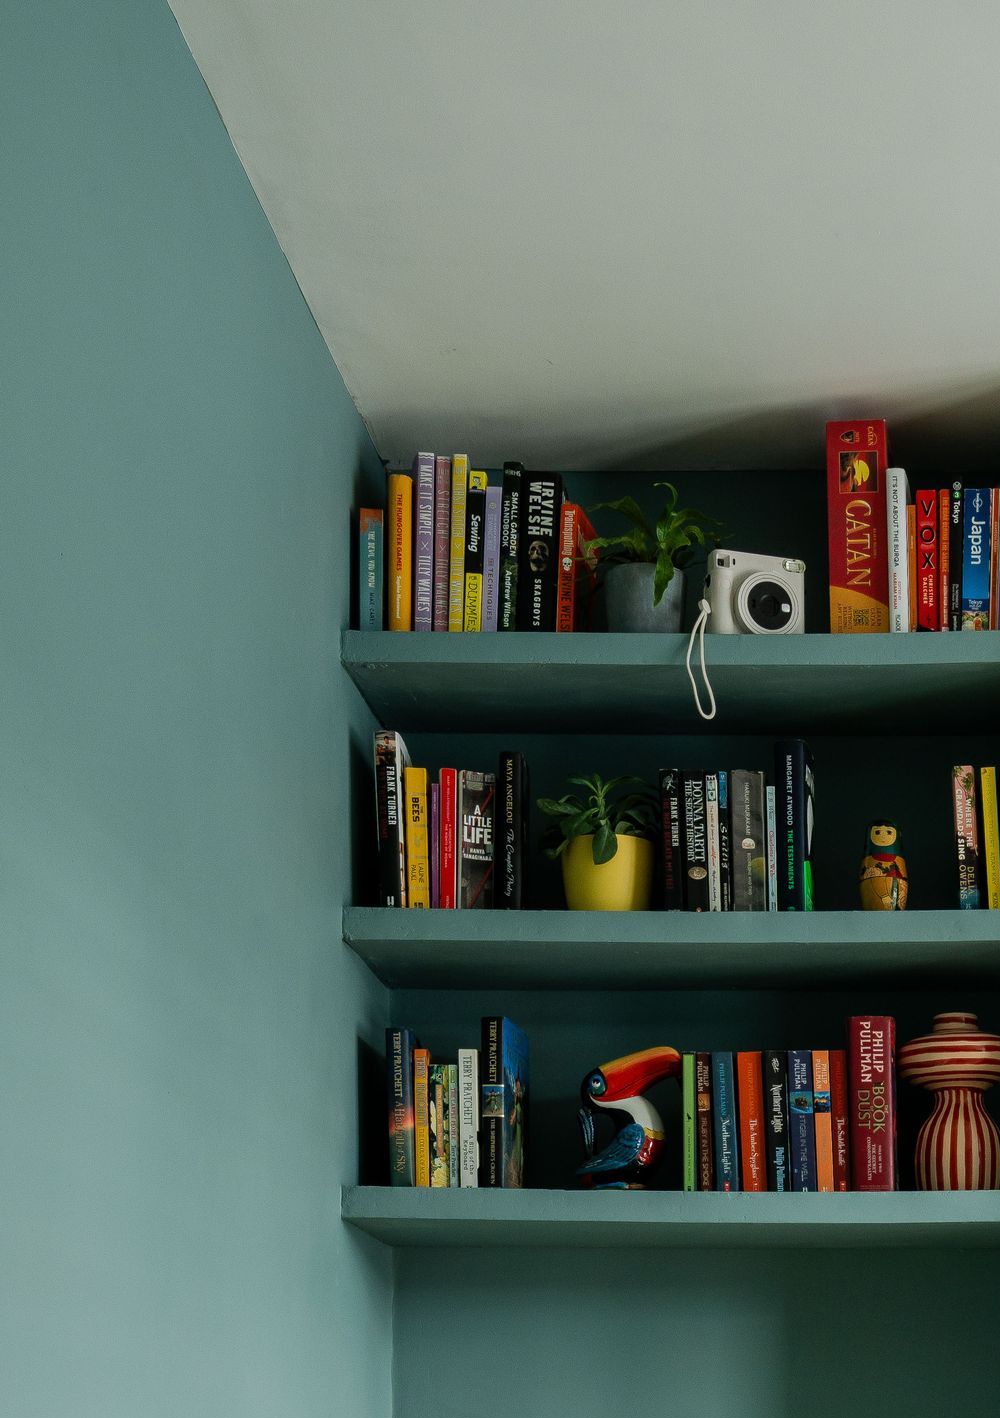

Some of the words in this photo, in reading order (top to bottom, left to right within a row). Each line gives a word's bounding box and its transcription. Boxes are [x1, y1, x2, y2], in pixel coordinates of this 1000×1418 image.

[420, 465, 432, 488] MAKE
[419, 504, 431, 535] SIMPLE
[437, 490, 449, 539] STRETCH!
[510, 492, 519, 519] SMALL
[528, 481, 542, 535] WELSH
[540, 481, 555, 537] IRVINE
[952, 500, 960, 523] Tokyo
[468, 514, 481, 552] Sewing
[502, 500, 510, 547] HANDBOOK
[562, 510, 576, 556] Trainspotting
[920, 499, 936, 569] VOX
[509, 522, 518, 557] GARDEN
[845, 499, 872, 587] CATAN
[968, 516, 986, 565] Japan
[418, 555, 430, 576] TILLY
[436, 558, 448, 579] TILLY
[418, 578, 430, 611] WALNES
[436, 582, 448, 614] WALNES
[504, 570, 512, 600] Andrew
[561, 573, 572, 602] IRVINE
[466, 583, 478, 632] DUMMIES
[503, 602, 511, 628] Wilson
[532, 579, 542, 627] SKAGBOYS
[386, 766, 396, 792] FRANK
[684, 779, 692, 796] THE
[388, 795, 397, 825] TURNER
[411, 797, 420, 822] BEES
[474, 804, 481, 815] A
[670, 797, 678, 819] FRANK
[685, 797, 693, 828] SECRET
[692, 780, 704, 820] DONNA
[955, 788, 964, 837] CRAWDADS
[463, 826, 492, 844] LIFE
[464, 814, 492, 828] LITTLE
[671, 822, 679, 847] TURNER
[506, 829, 514, 844] The
[686, 829, 695, 862] HISTORY
[694, 823, 705, 862] TARTT
[720, 822, 728, 869] Skellig
[958, 838, 966, 860] SING
[505, 844, 514, 873] Complete
[504, 874, 514, 897] Poetry
[959, 864, 968, 900] OWENS
[967, 866, 975, 895] DELIA
[393, 1032, 401, 1054] TERRY
[489, 1020, 497, 1042] TERRY
[489, 1042, 497, 1083] PRATCHETT
[860, 1021, 872, 1083] PULLMAN
[872, 1030, 884, 1073] PHILIP
[394, 1055, 403, 1098] PRATCHETT
[463, 1056, 472, 1078] TERRY
[463, 1082, 473, 1126] PRATCHETT
[770, 1083, 783, 1112] Northern
[857, 1089, 871, 1130] DUST
[872, 1086, 886, 1133] BOOK
[721, 1118, 730, 1151] Northern
[749, 1118, 757, 1131] The
[771, 1114, 783, 1133] Lights
[462, 1139, 470, 1170] Keyboard
[800, 1139, 806, 1148] IN
[837, 1131, 845, 1149] Subtle
[394, 1155, 406, 1174] Sky
[721, 1151, 731, 1174] Lights
[749, 1152, 759, 1179] Spyglass
[773, 1147, 785, 1166] Philip
